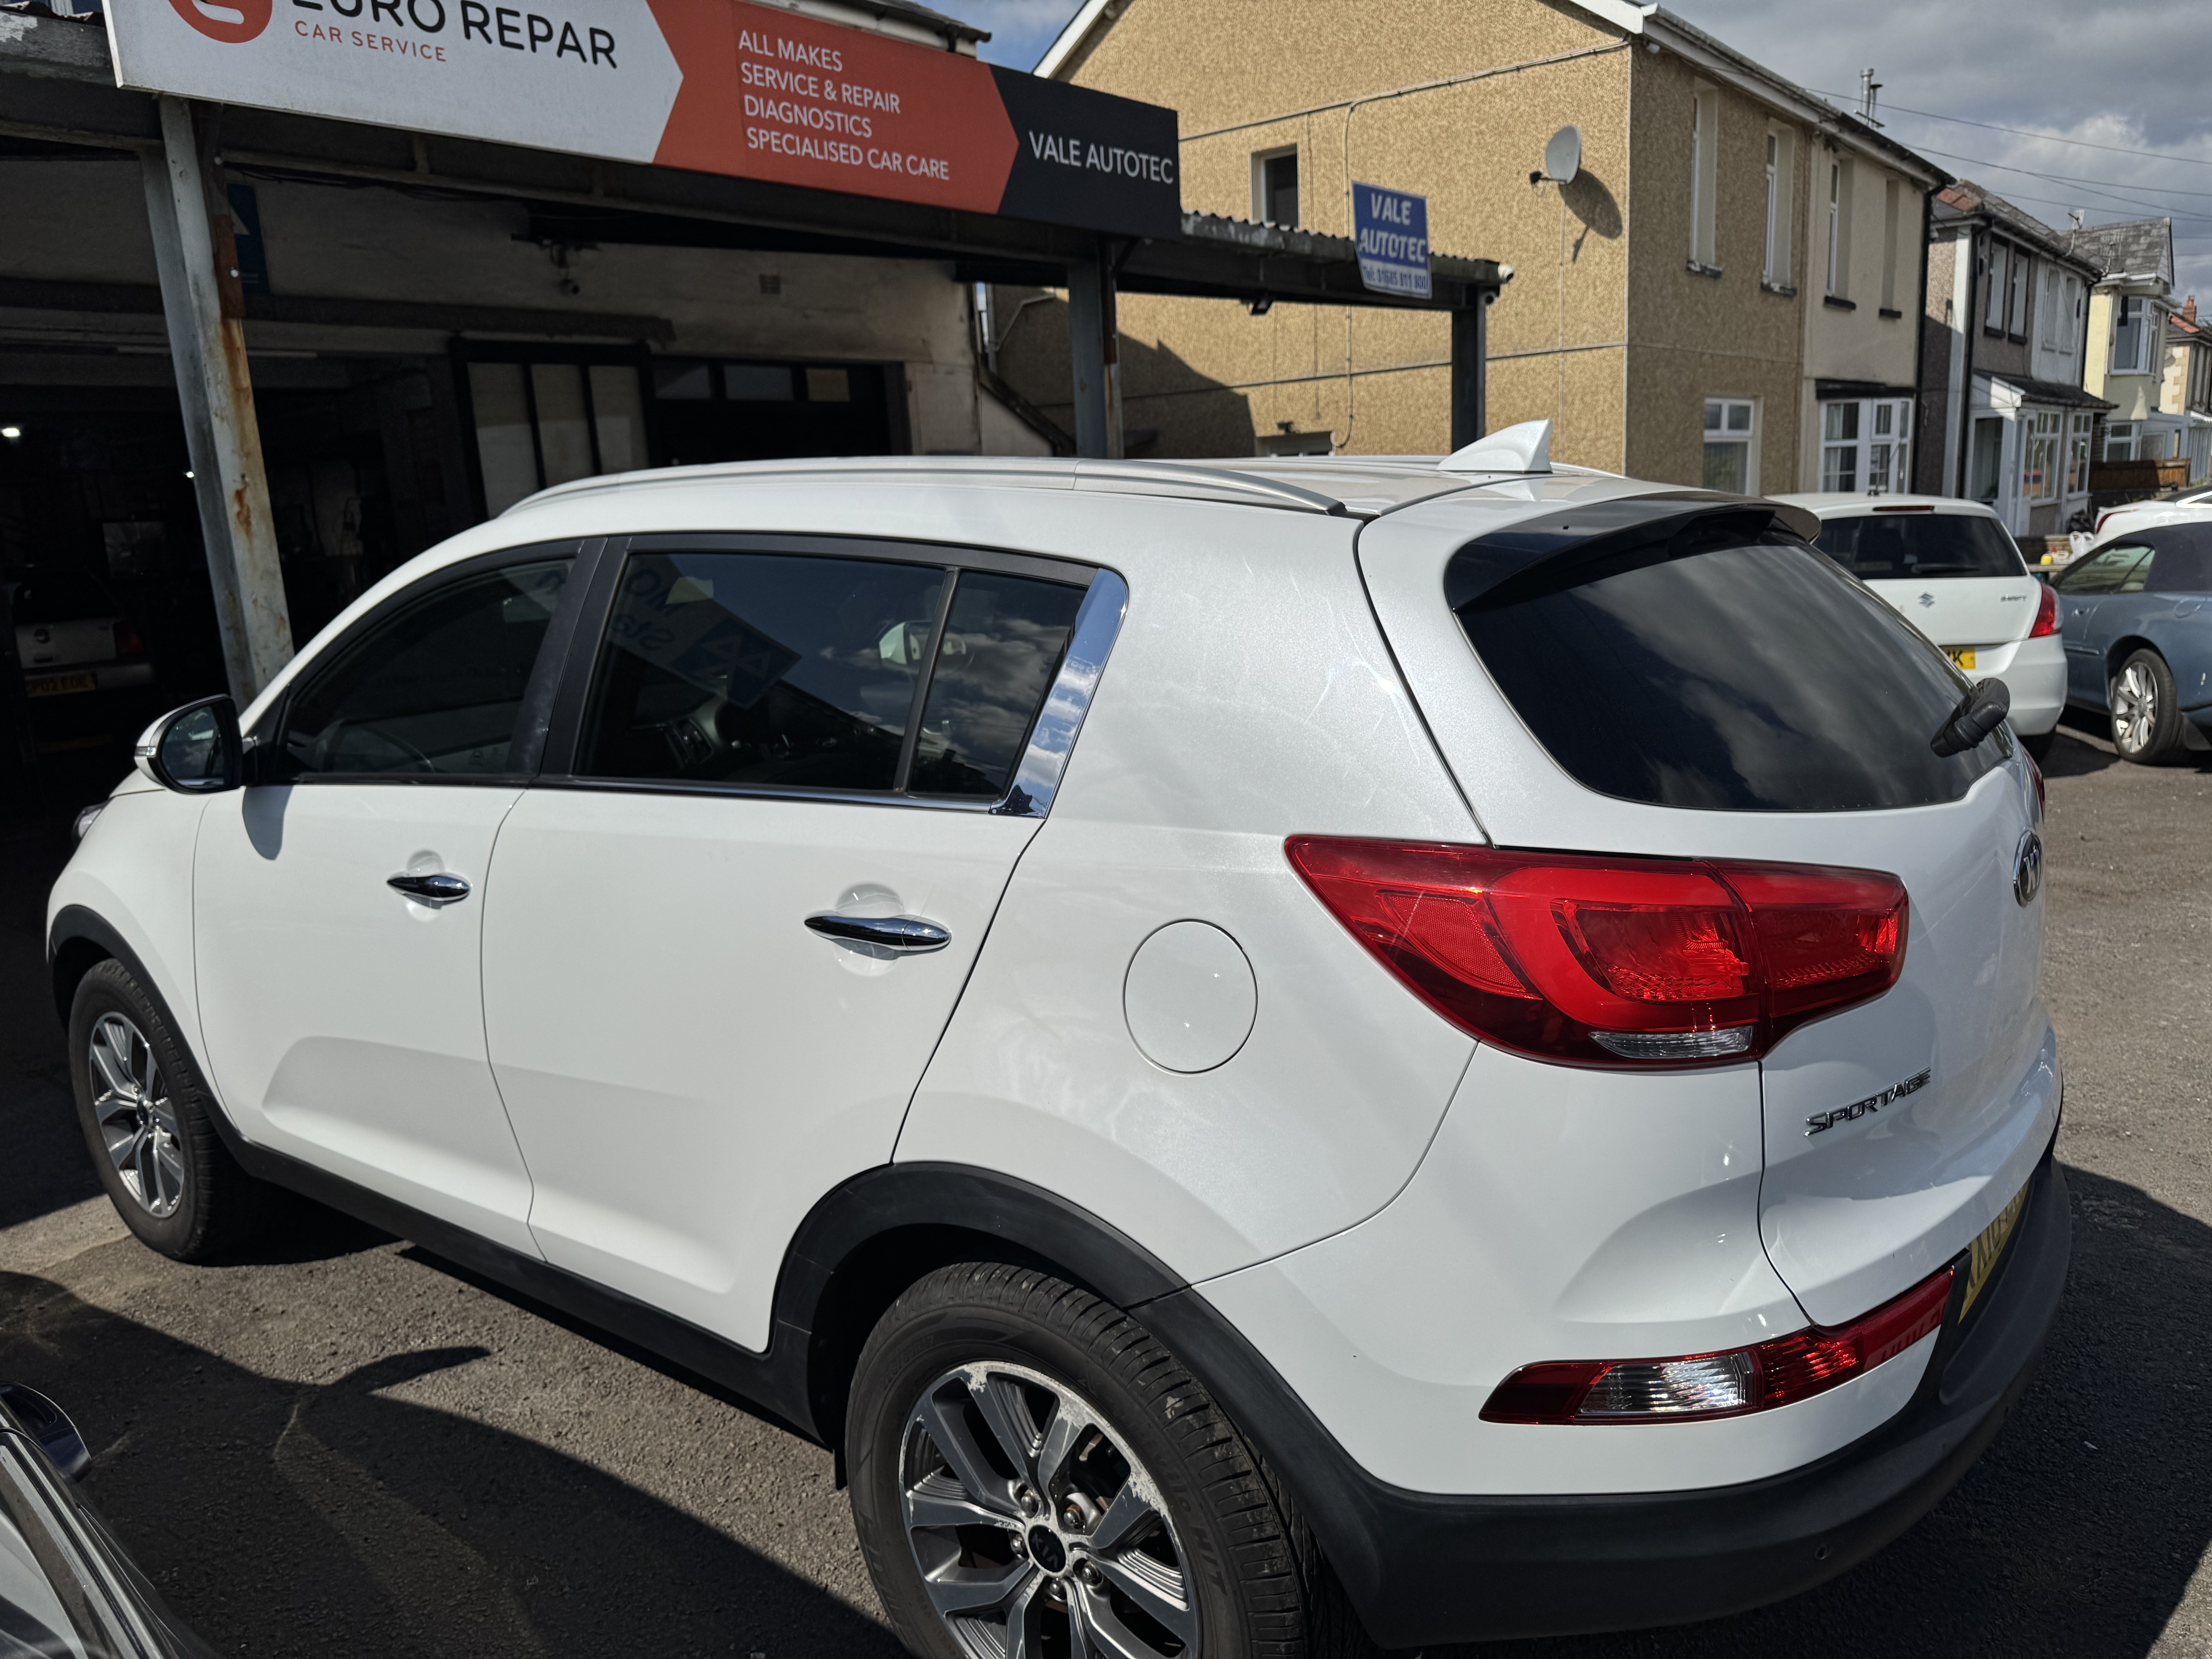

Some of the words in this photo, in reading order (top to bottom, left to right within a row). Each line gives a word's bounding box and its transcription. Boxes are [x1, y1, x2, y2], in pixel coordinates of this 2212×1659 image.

[295, 21, 342, 43] CAR
[352, 31, 446, 62] SERVICE
[460, 0, 617, 69] REPAR
[738, 30, 775, 57] ALL
[778, 37, 843, 72] MAKES
[741, 62, 819, 98] SERVICE
[824, 80, 837, 102] &
[842, 82, 901, 115] REPAIR
[744, 94, 872, 139] DIAGNOSTICS
[747, 127, 863, 166] SPECIALISED
[867, 148, 903, 173] CAR
[906, 155, 950, 181] CARE
[1028, 129, 1082, 167] VALE
[1085, 143, 1174, 185] AUTOTEC
[1371, 193, 1412, 225] VALE
[1359, 227, 1426, 263] AUTOTEC
[1804, 1066, 1931, 1137] SPORTAGE
[1030, 1531, 1058, 1570] KIA
